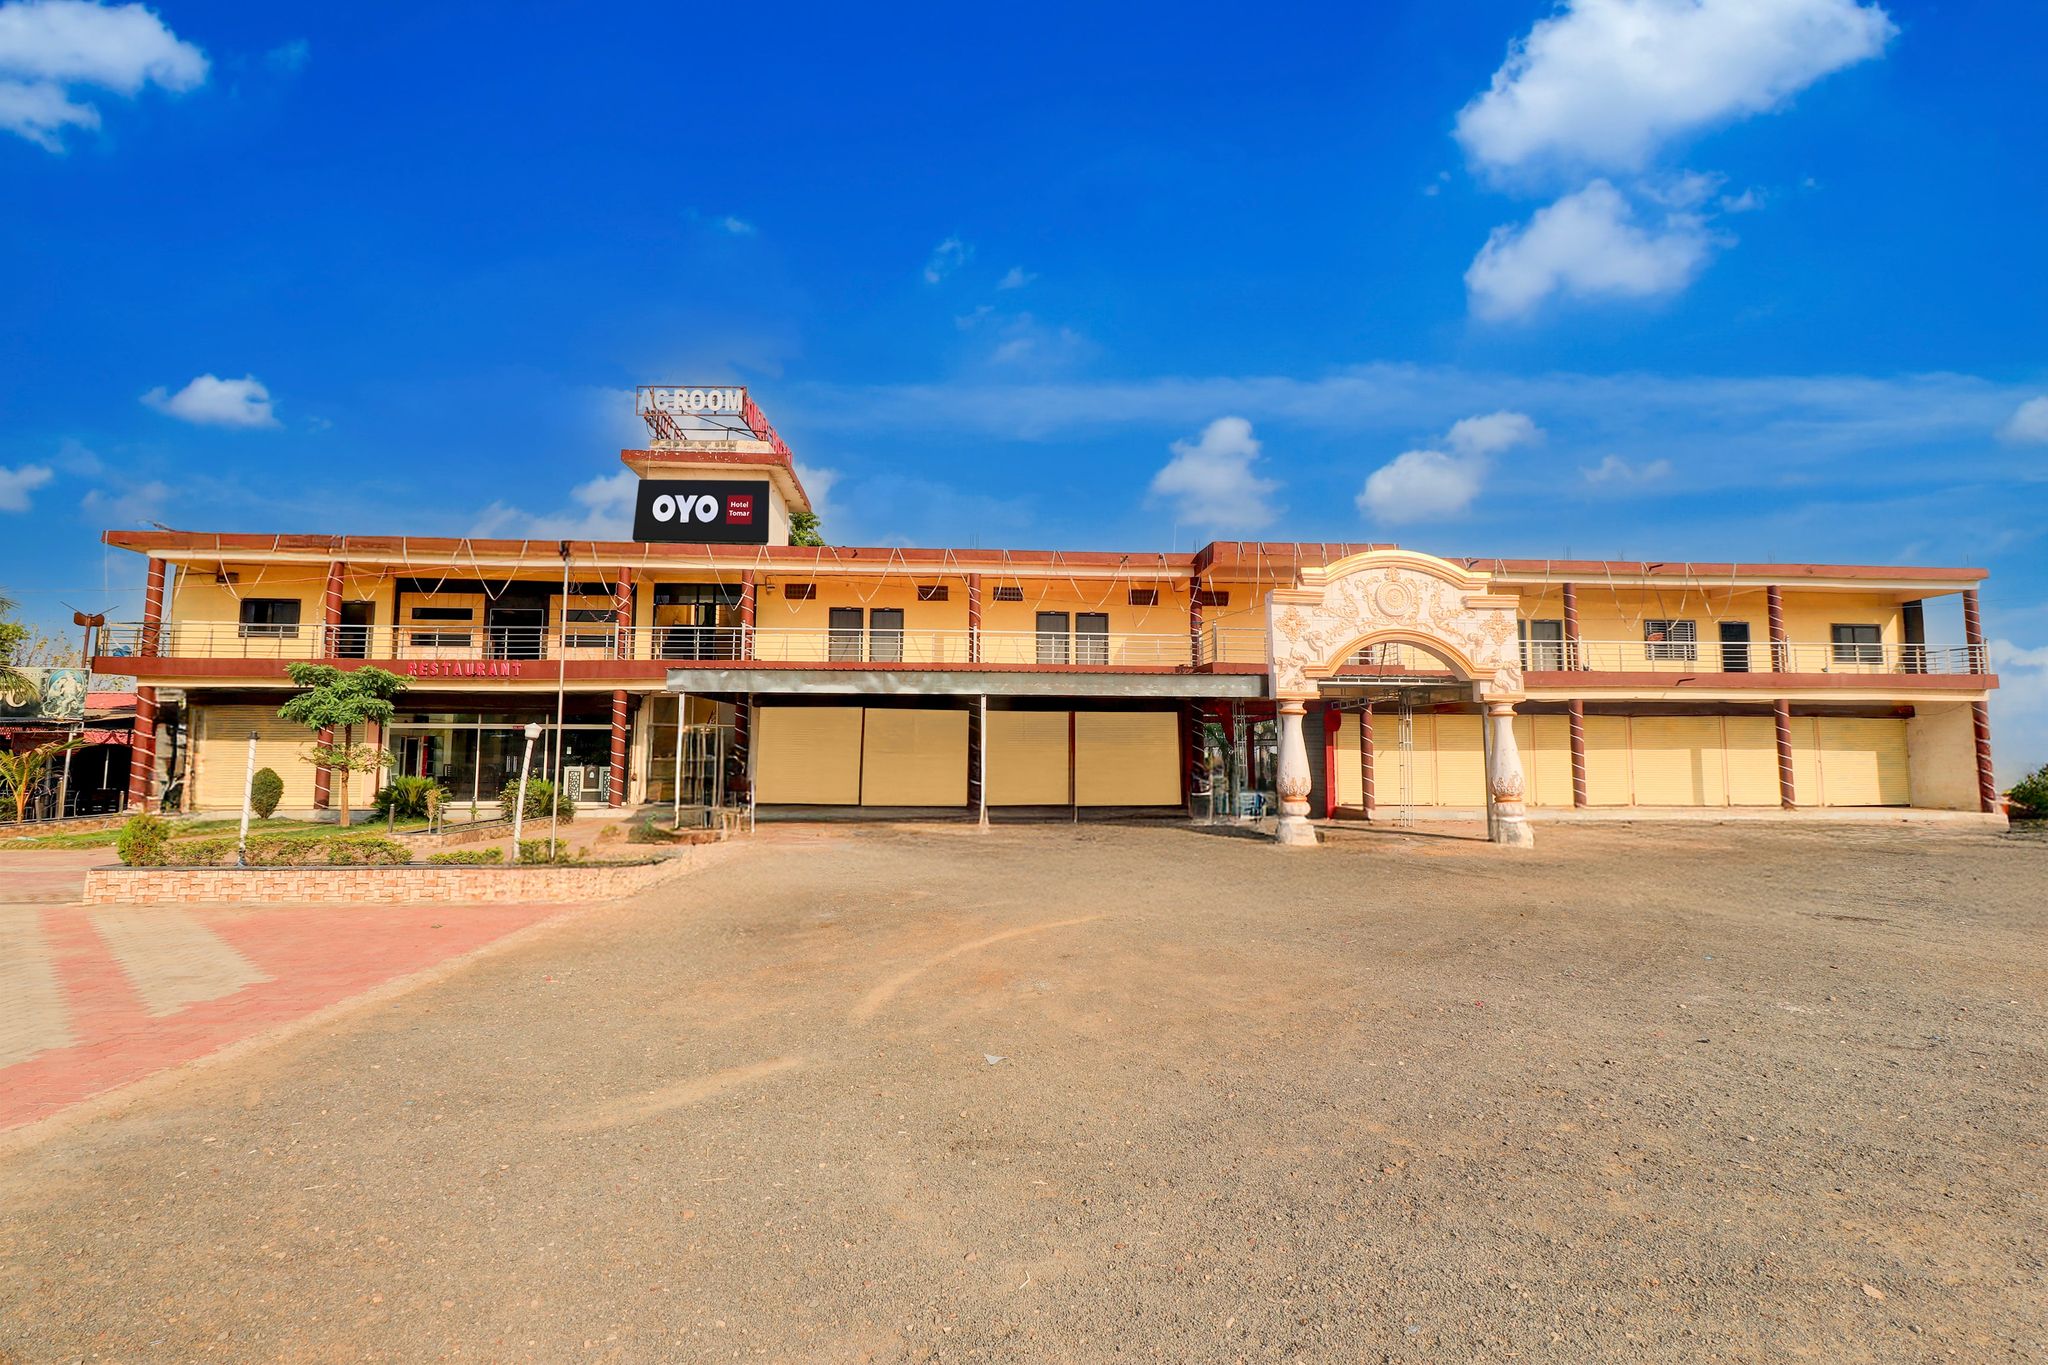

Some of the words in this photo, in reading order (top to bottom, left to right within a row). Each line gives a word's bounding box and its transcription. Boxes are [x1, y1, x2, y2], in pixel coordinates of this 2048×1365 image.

[673, 389, 743, 411] ROOM
[652, 494, 719, 523] OYO
[407, 661, 522, 676] RESTAURANT
